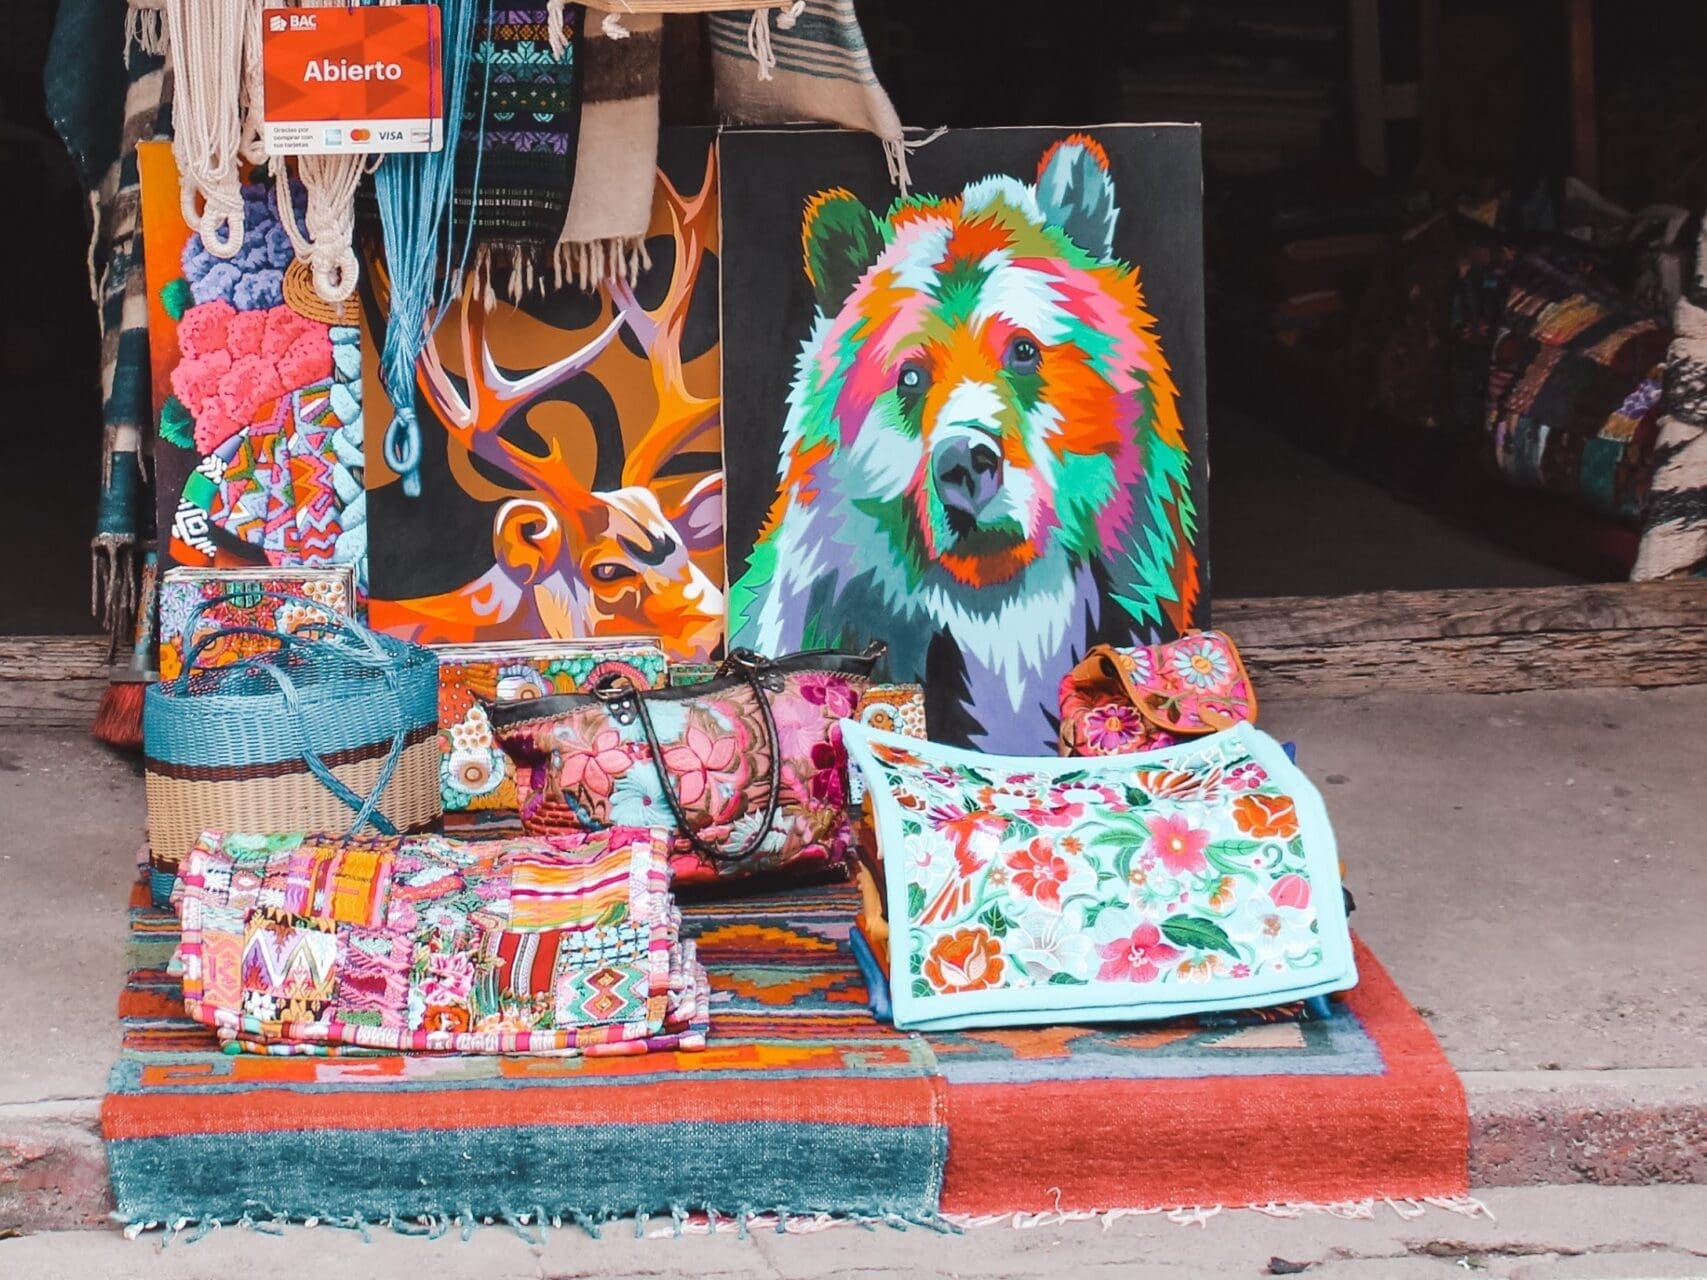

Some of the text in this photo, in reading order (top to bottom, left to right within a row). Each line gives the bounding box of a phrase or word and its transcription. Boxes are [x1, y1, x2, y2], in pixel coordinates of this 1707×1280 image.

[290, 15, 316, 27] BAC
[303, 60, 402, 81] Abierto
[379, 131, 404, 140] VISA
